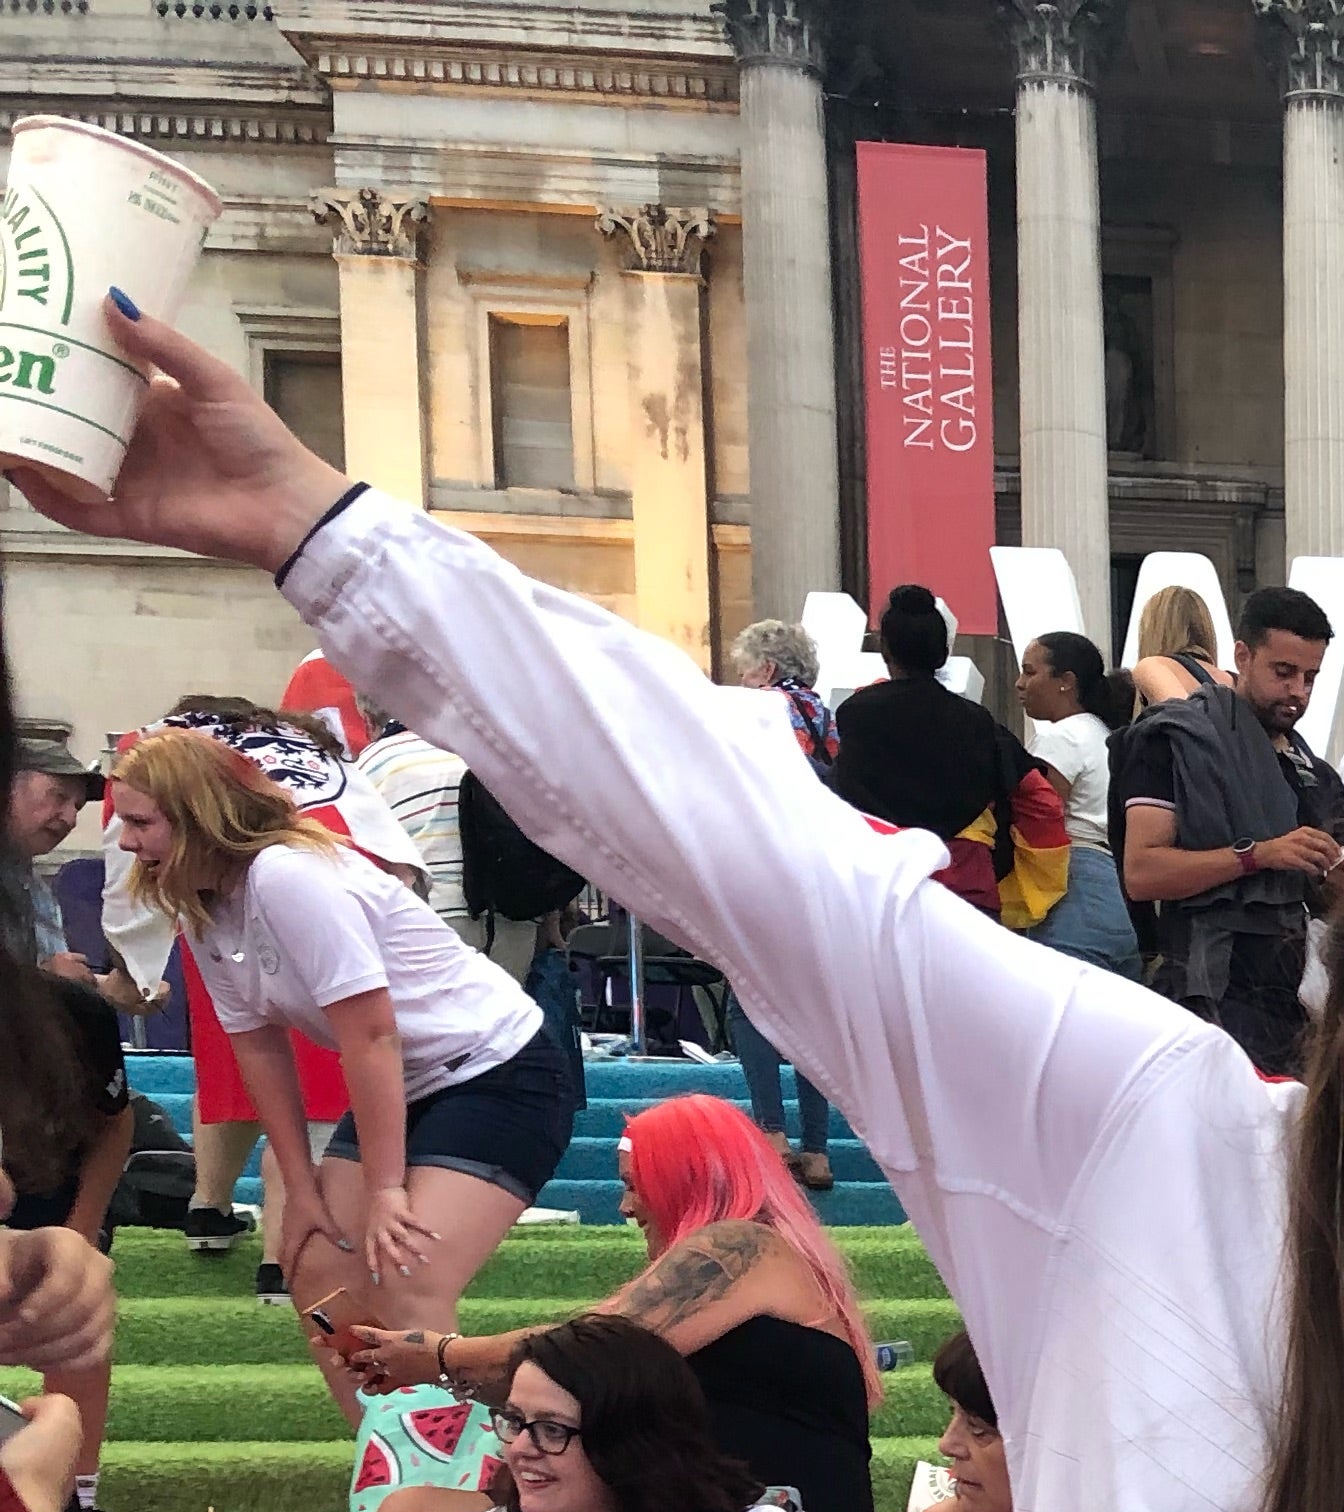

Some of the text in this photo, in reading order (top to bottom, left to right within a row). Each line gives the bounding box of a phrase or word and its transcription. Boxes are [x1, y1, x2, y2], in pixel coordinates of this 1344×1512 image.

[3, 187, 50, 305] UALITY
[880, 345, 897, 389] THE
[898, 222, 934, 451] NATIONAL
[936, 224, 977, 452] GALLERY
